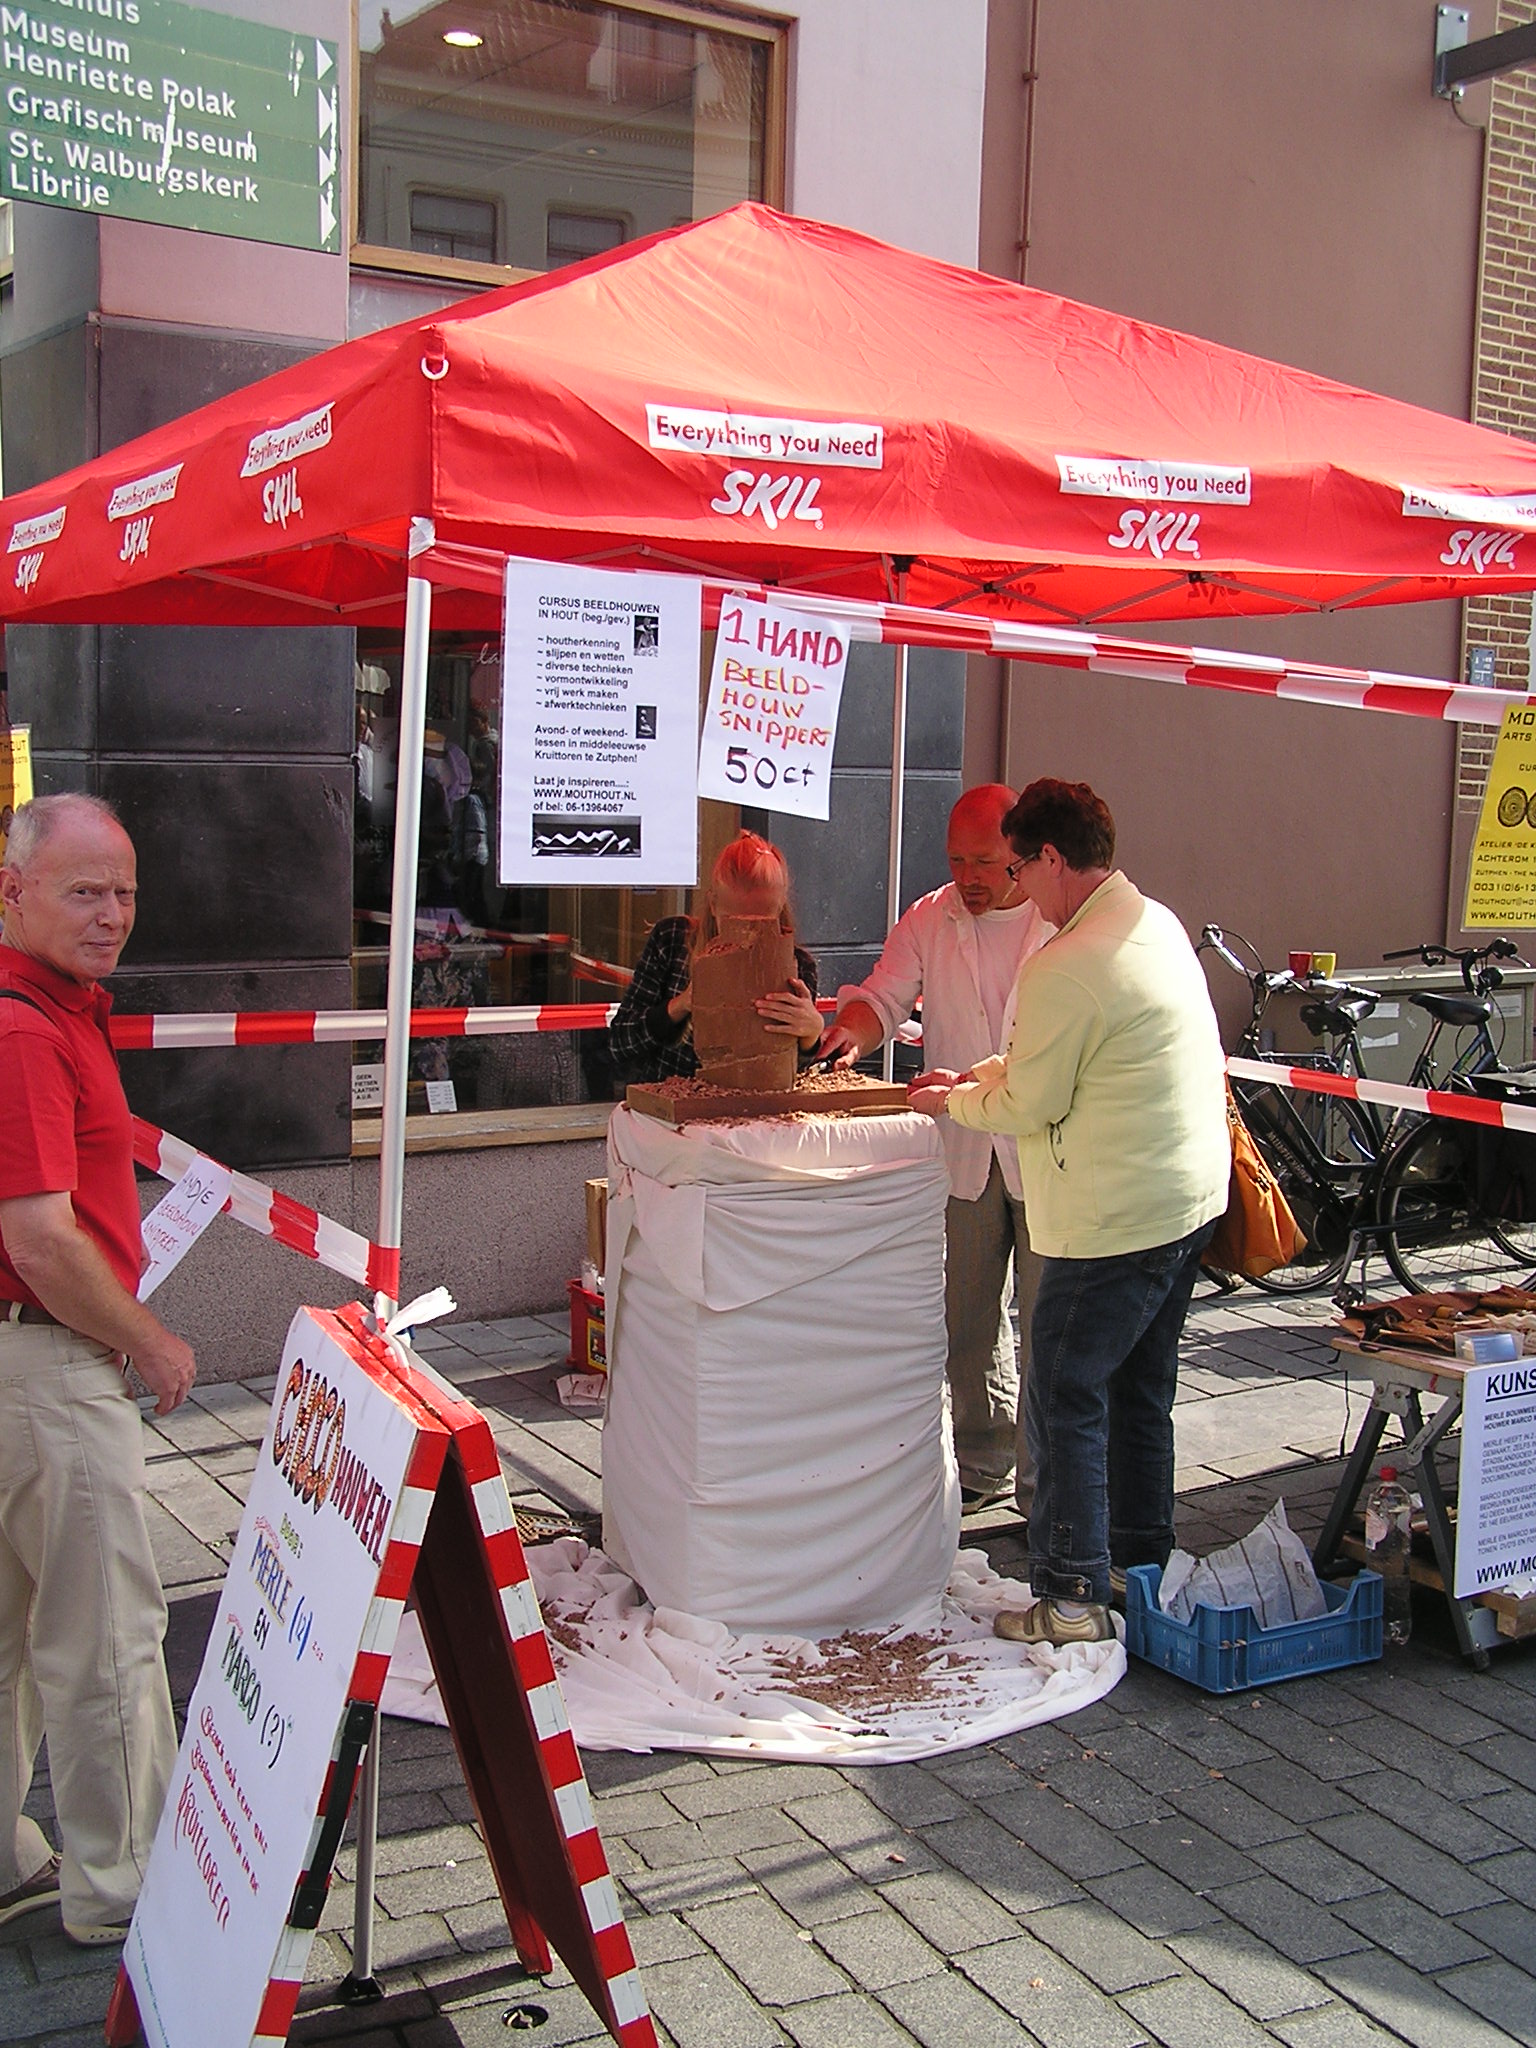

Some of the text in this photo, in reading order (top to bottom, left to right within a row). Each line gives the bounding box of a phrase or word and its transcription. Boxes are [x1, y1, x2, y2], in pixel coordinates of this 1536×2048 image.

[1, 6, 130, 64] Museum
[4, 41, 236, 119] Henriette Polak
[7, 87, 257, 163] Grafisch museum
[9, 131, 259, 203] St. Walburgskerk
[10, 163, 110, 207] Librije
[656, 414, 878, 457] Everything you Need
[1066, 465, 1246, 496] Everything you Need
[263, 466, 302, 530] SKIL
[711, 469, 823, 530] SKIL
[1108, 509, 1200, 560] SKIL
[1440, 530, 1524, 574] SKIL
[539, 596, 660, 614] CURSUS BEELDHOUWEN
[539, 609, 549, 619] IN
[551, 610, 579, 621] HOUT
[546, 636, 620, 651] houtherkenning
[723, 608, 844, 668] 1 HAND
[545, 648, 625, 662] slijpen en wetten
[545, 661, 633, 675] diverse technieken
[545, 675, 629, 689] vormontwikkeling
[544, 687, 618, 699] vrij werk maken
[544, 699, 627, 712] afwerktechnieken
[722, 688, 804, 718] HOUW
[535, 725, 628, 737] Avond- of weekend-
[1503, 732, 1532, 741] ARTS
[535, 738, 646, 751] lessen in middeleeuwse
[534, 751, 638, 764] Kruittoren te Zutphen!
[534, 776, 555, 786] Laat
[556, 777, 566, 788] je
[534, 789, 637, 801] WWW.MOUTHOUT.NL
[533, 802, 544, 811] of
[546, 802, 563, 811] bel:
[1477, 855, 1529, 863] ACHTEROM
[1471, 911, 1536, 920] WWW.MOUTH
[249, 1531, 292, 1624] MERLE
[254, 1607, 270, 1650] EN
[221, 1626, 261, 1724] MARCO
[261, 1704, 285, 1769] (?)
